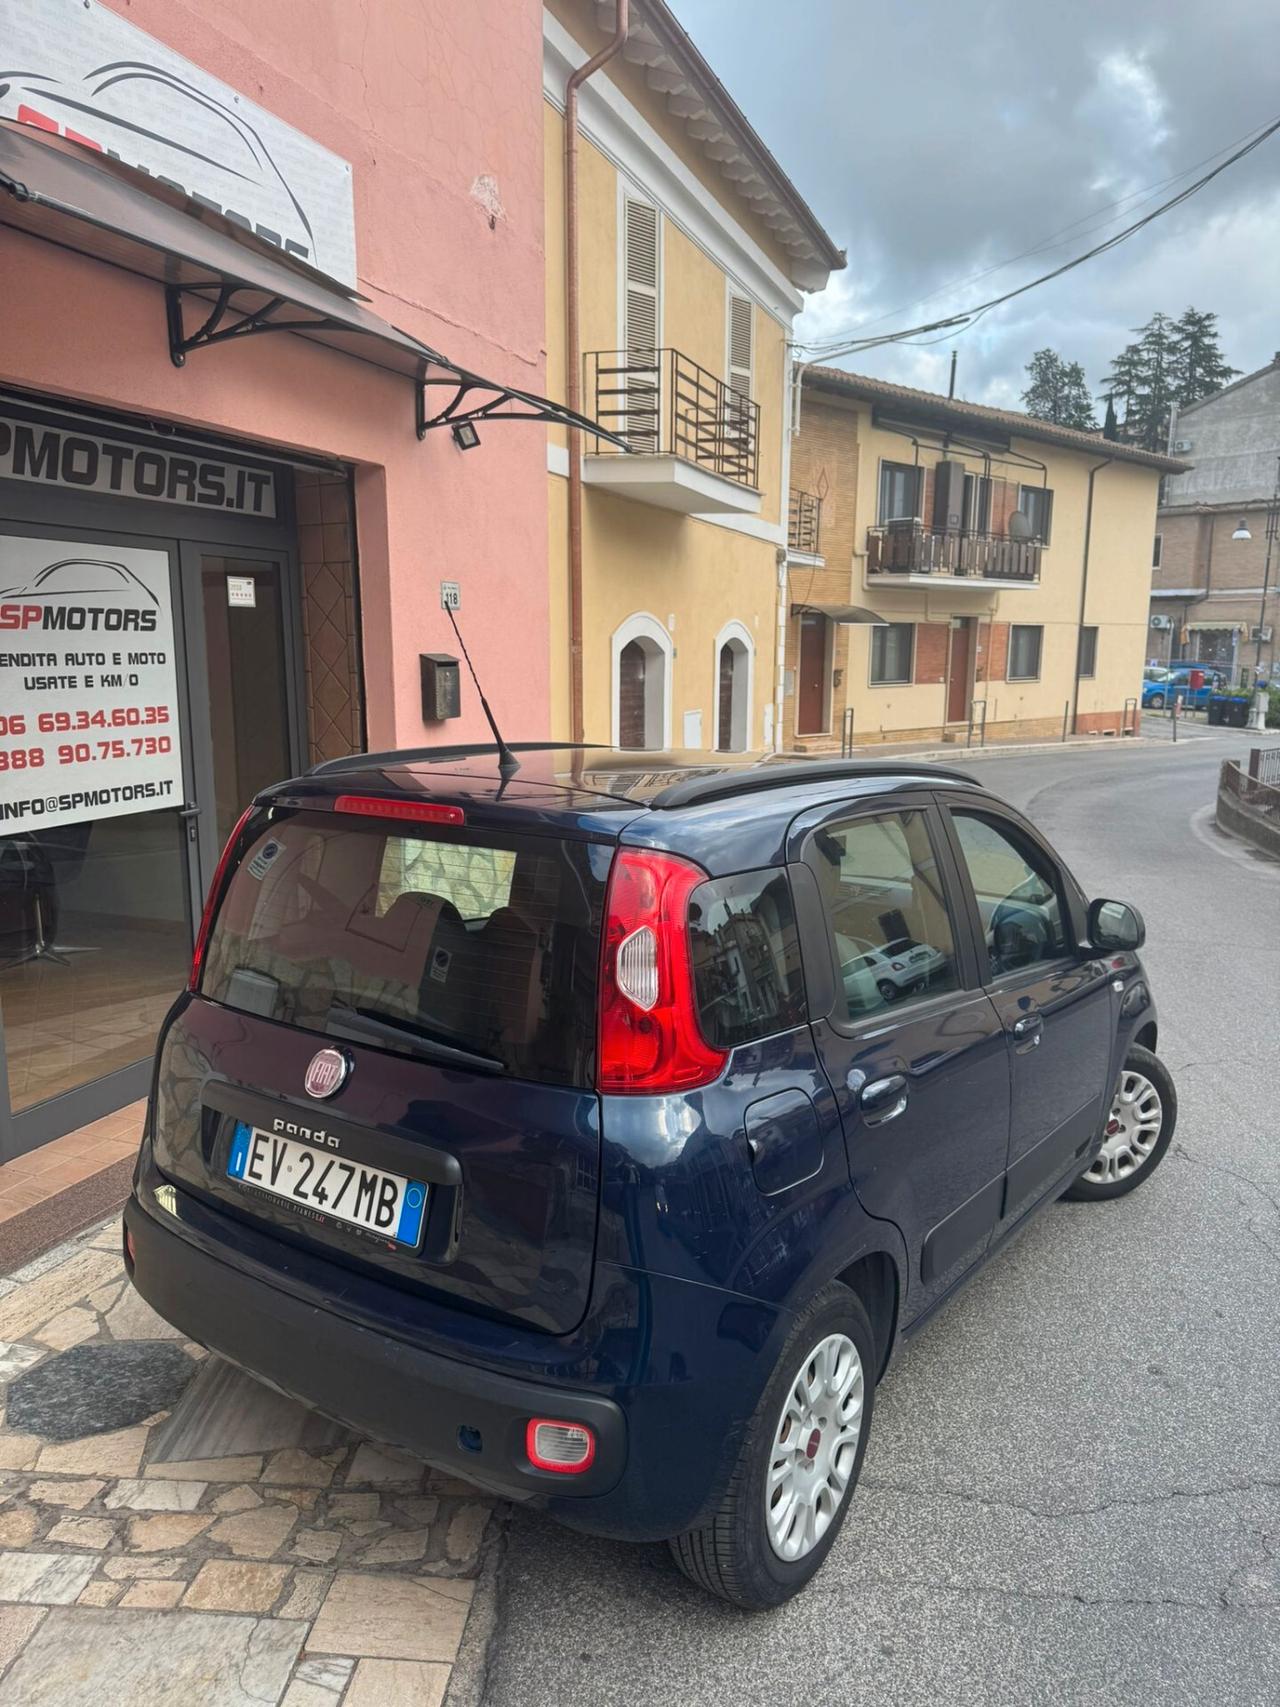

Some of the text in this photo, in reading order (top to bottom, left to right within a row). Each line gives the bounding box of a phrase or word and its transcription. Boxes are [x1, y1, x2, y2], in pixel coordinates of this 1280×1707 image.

[0, 604, 157, 631] SPMOTORS
[65, 652, 106, 666] AUTO
[113, 652, 121, 665] E
[128, 652, 166, 665] MOTO
[24, 675, 77, 690] USATE
[84, 675, 94, 688] E
[38, 705, 170, 733] 69.34.60.35
[57, 735, 171, 765] 90.75.730
[0, 780, 173, 820] INFO@SPMOTORS.IT
[311, 1061, 338, 1086] FIAT
[273, 1118, 340, 1148] panda
